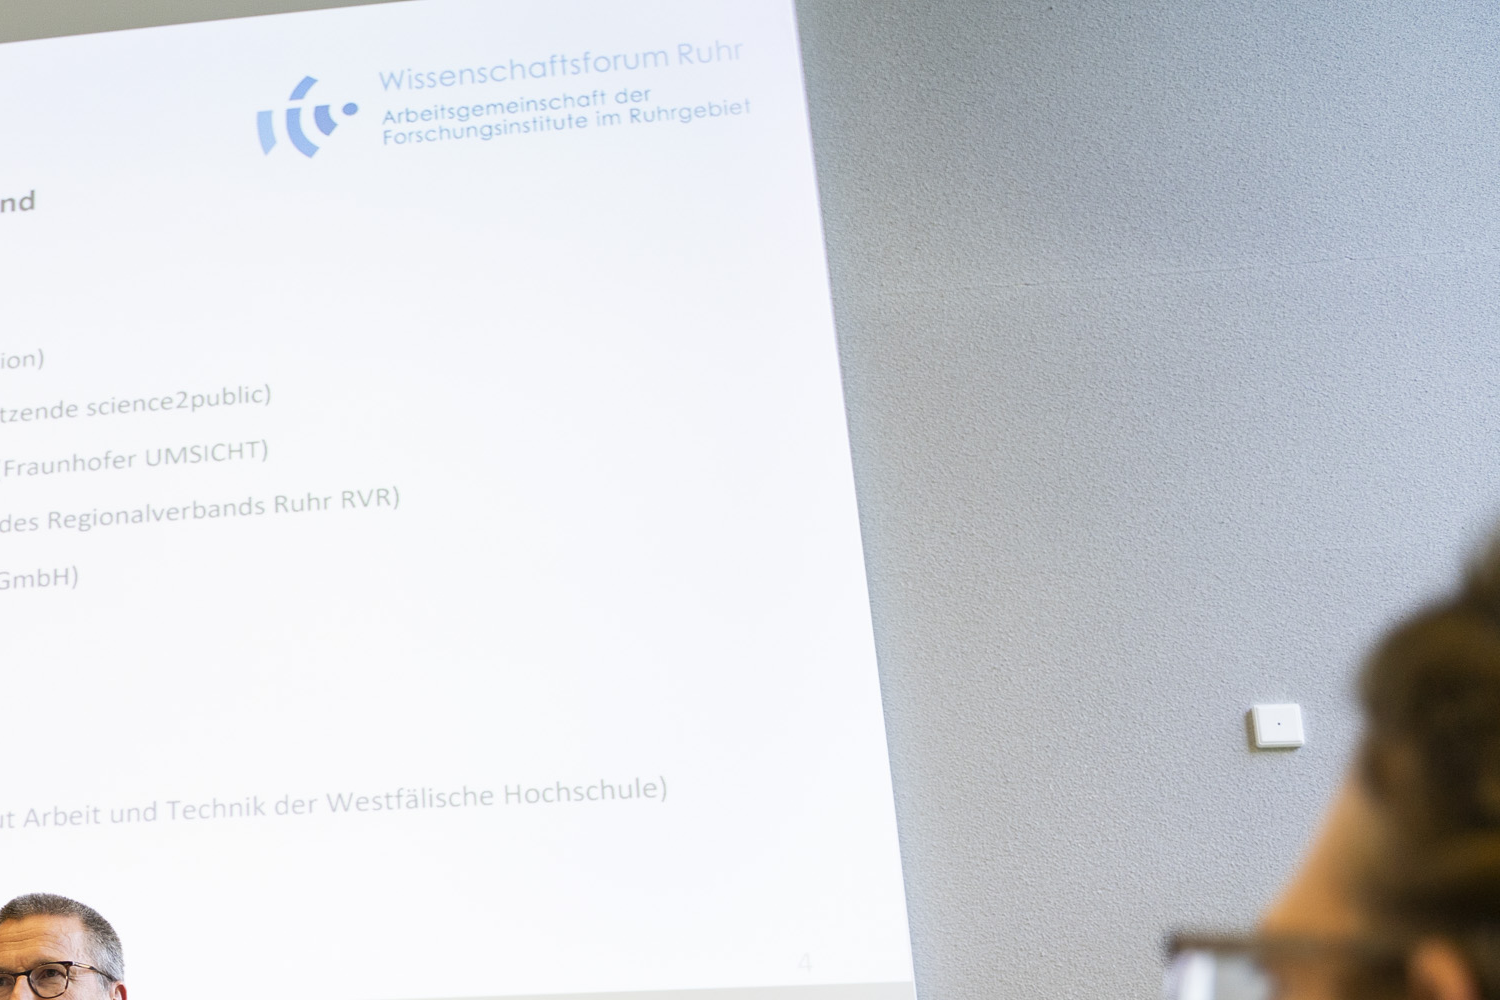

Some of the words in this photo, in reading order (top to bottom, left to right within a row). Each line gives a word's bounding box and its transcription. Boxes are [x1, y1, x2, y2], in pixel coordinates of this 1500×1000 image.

[379, 50, 668, 91] Wissenschaftsforum
[677, 40, 742, 65] Ruhr
[382, 88, 607, 125] Arbeitsgemeinschaft
[615, 89, 650, 104] der
[382, 112, 589, 146] Forschungsinstitute
[596, 111, 621, 126] im
[629, 99, 750, 124] Ruhrgebiet
[87, 384, 271, 416] science2public)
[146, 439, 268, 467] UMSICHT)
[48, 496, 265, 532] Regionalverbands
[275, 493, 331, 513] Ruhr
[342, 486, 400, 509] RVR)
[23, 805, 100, 827] Arbeit
[111, 801, 157, 823] und
[166, 796, 265, 820] Technik
[275, 794, 317, 815] der
[326, 786, 494, 812] Westfälische
[505, 776, 667, 804] Hochschule)
